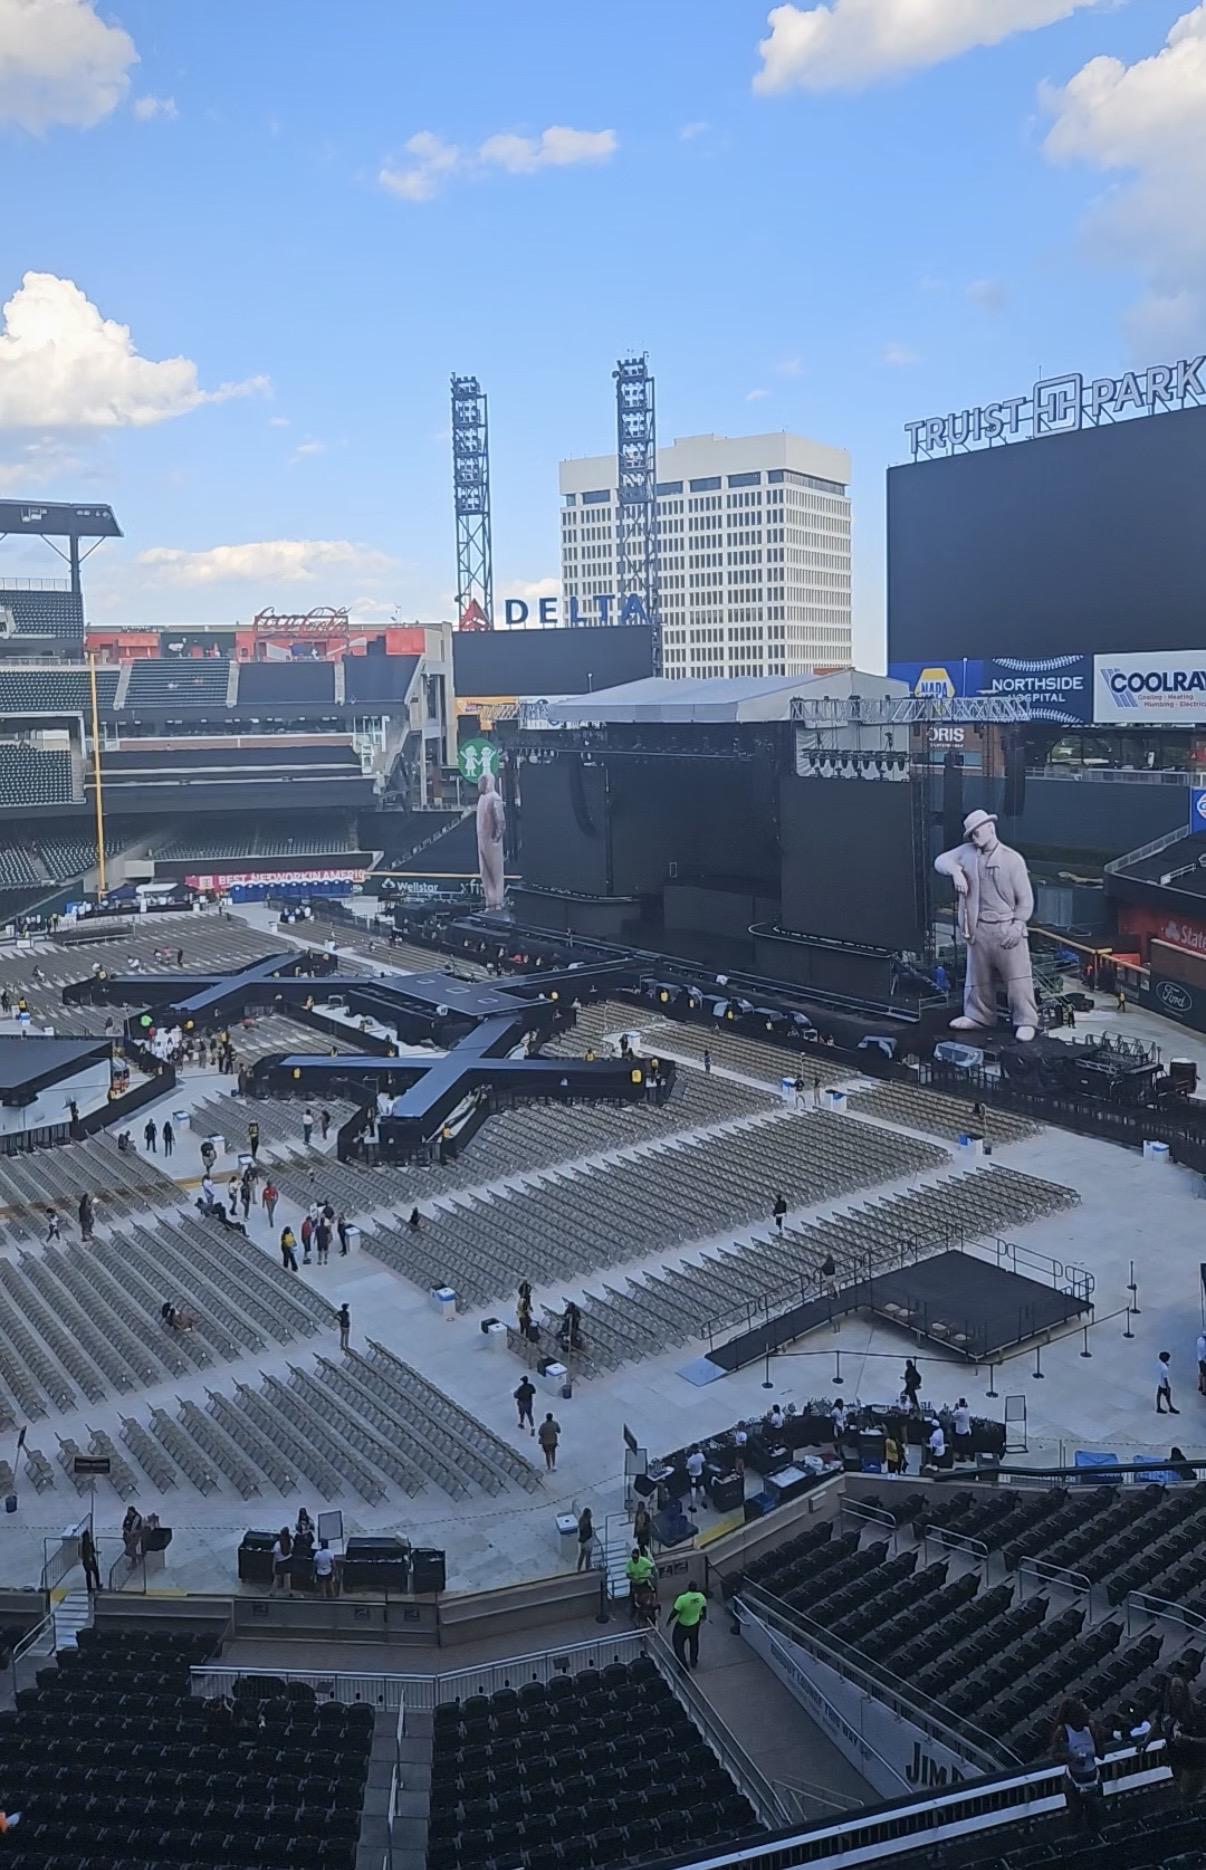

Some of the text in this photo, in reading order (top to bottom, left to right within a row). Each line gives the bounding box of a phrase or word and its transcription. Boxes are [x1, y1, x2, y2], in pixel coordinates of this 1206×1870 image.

[904, 355, 1206, 454] TRUIST PARK
[505, 592, 652, 625] DELTA
[921, 681, 948, 697] NAPA
[992, 676, 1084, 692] NORTHSIDE
[396, 882, 439, 892] Wellstar
[1162, 983, 1187, 1008] Ford
